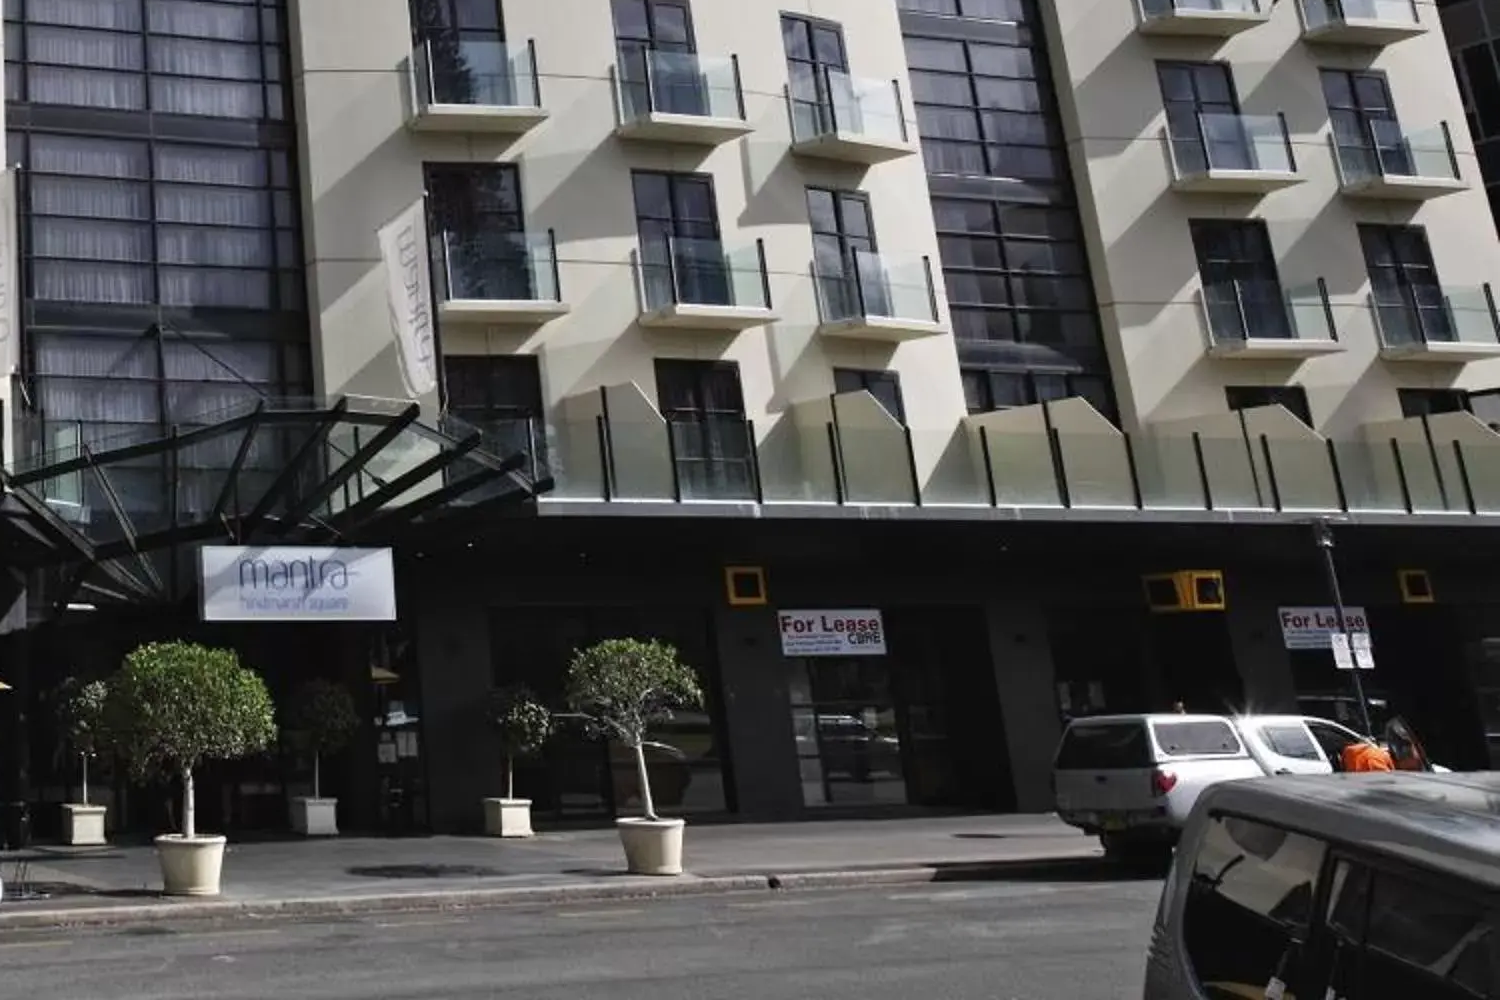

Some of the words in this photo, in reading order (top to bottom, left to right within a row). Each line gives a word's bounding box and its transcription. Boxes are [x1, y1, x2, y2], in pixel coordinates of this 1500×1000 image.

[239, 556, 356, 591] mantra
[781, 615, 815, 633] For
[821, 615, 878, 633] Lease
[1281, 611, 1310, 629] For
[1315, 611, 1365, 628] Lese
